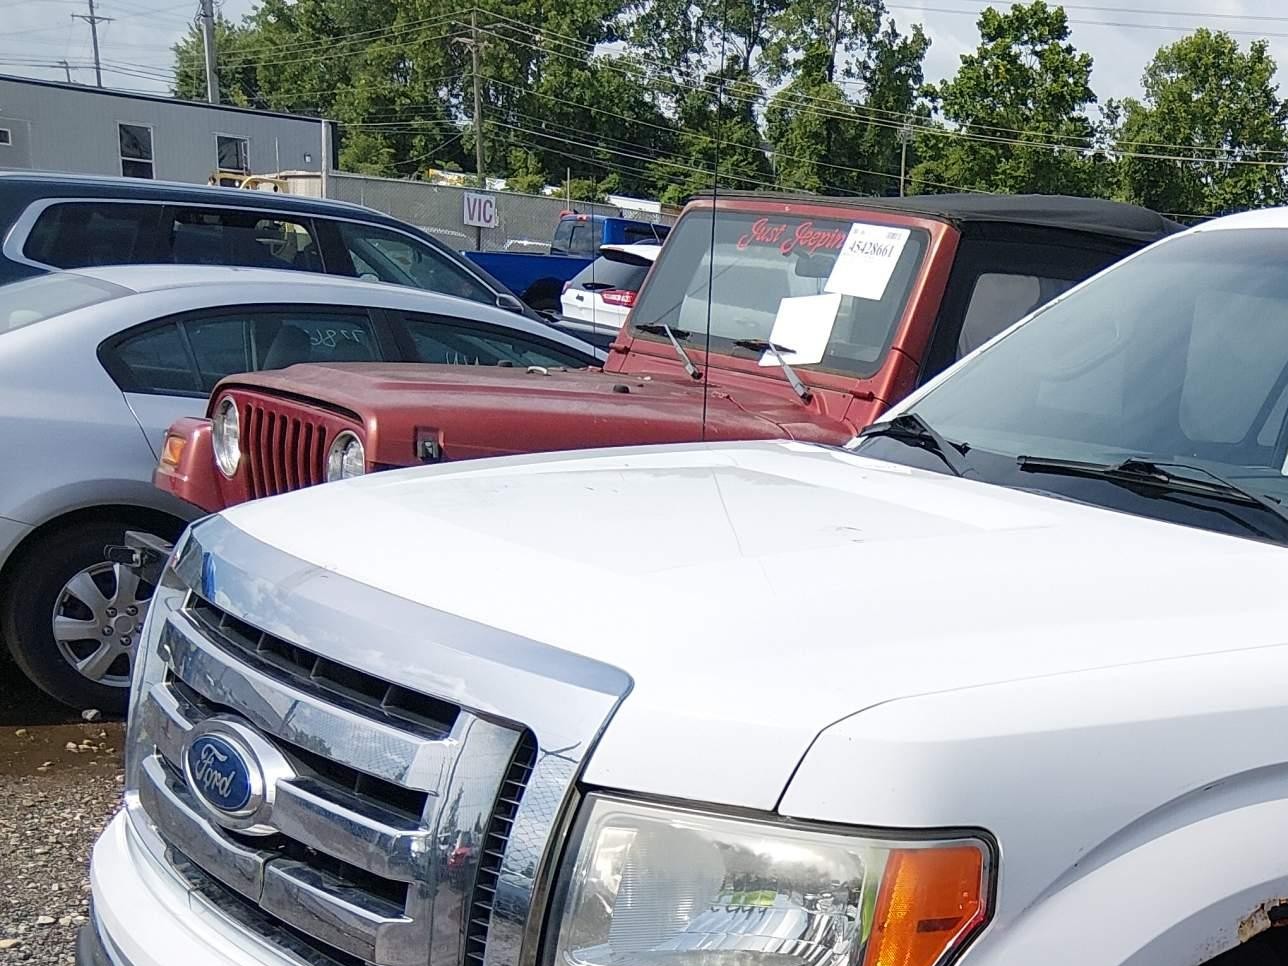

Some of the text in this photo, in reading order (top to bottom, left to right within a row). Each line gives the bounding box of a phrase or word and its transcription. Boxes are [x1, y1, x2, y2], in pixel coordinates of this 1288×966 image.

[467, 196, 493, 224] VIC
[736, 218, 787, 250] Just
[849, 239, 895, 258] 45428661
[195, 743, 236, 798] Ford
